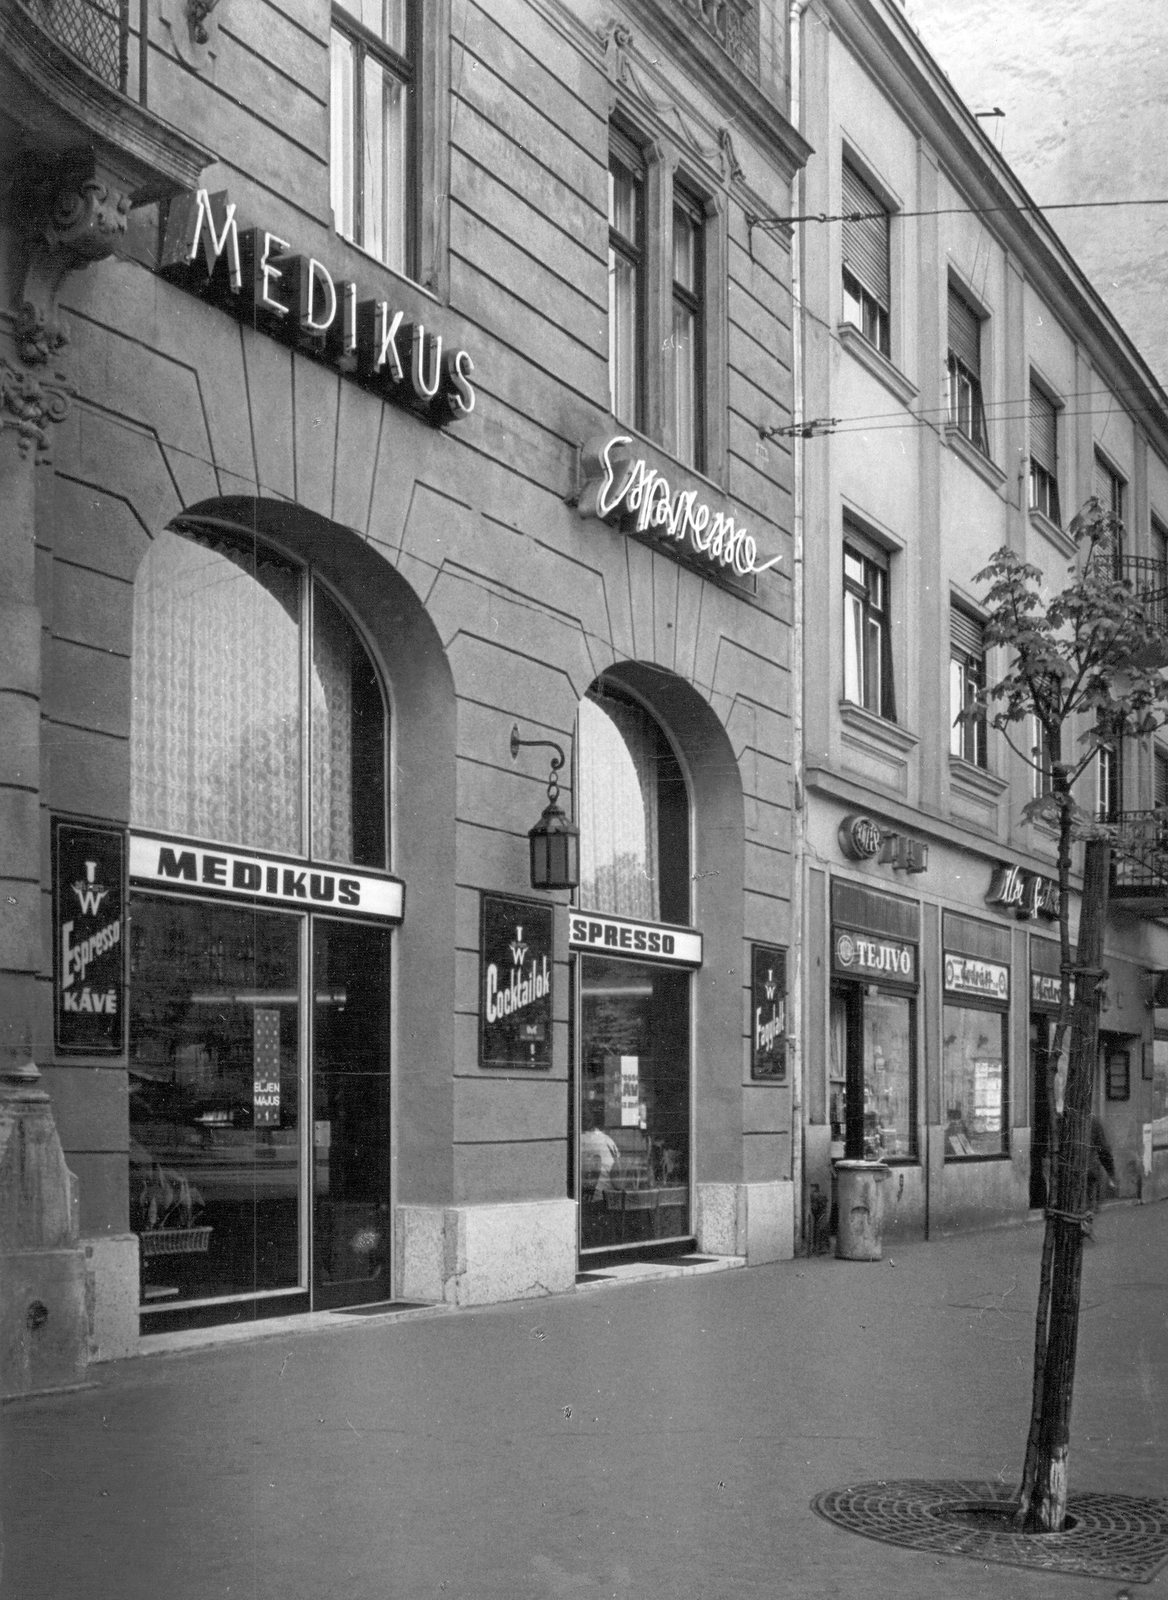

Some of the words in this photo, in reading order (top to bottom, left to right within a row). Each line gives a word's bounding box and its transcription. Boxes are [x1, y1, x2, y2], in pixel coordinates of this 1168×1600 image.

[190, 188, 476, 414] MEDIKUS
[157, 847, 362, 907] MEDIKUS
[62, 920, 121, 990] Espresso
[569, 919, 675, 955] SPRESSO
[857, 940, 911, 974] TEJIVÓ
[64, 987, 118, 1014] KÁVÉ
[486, 955, 550, 1024] Cocktailok
